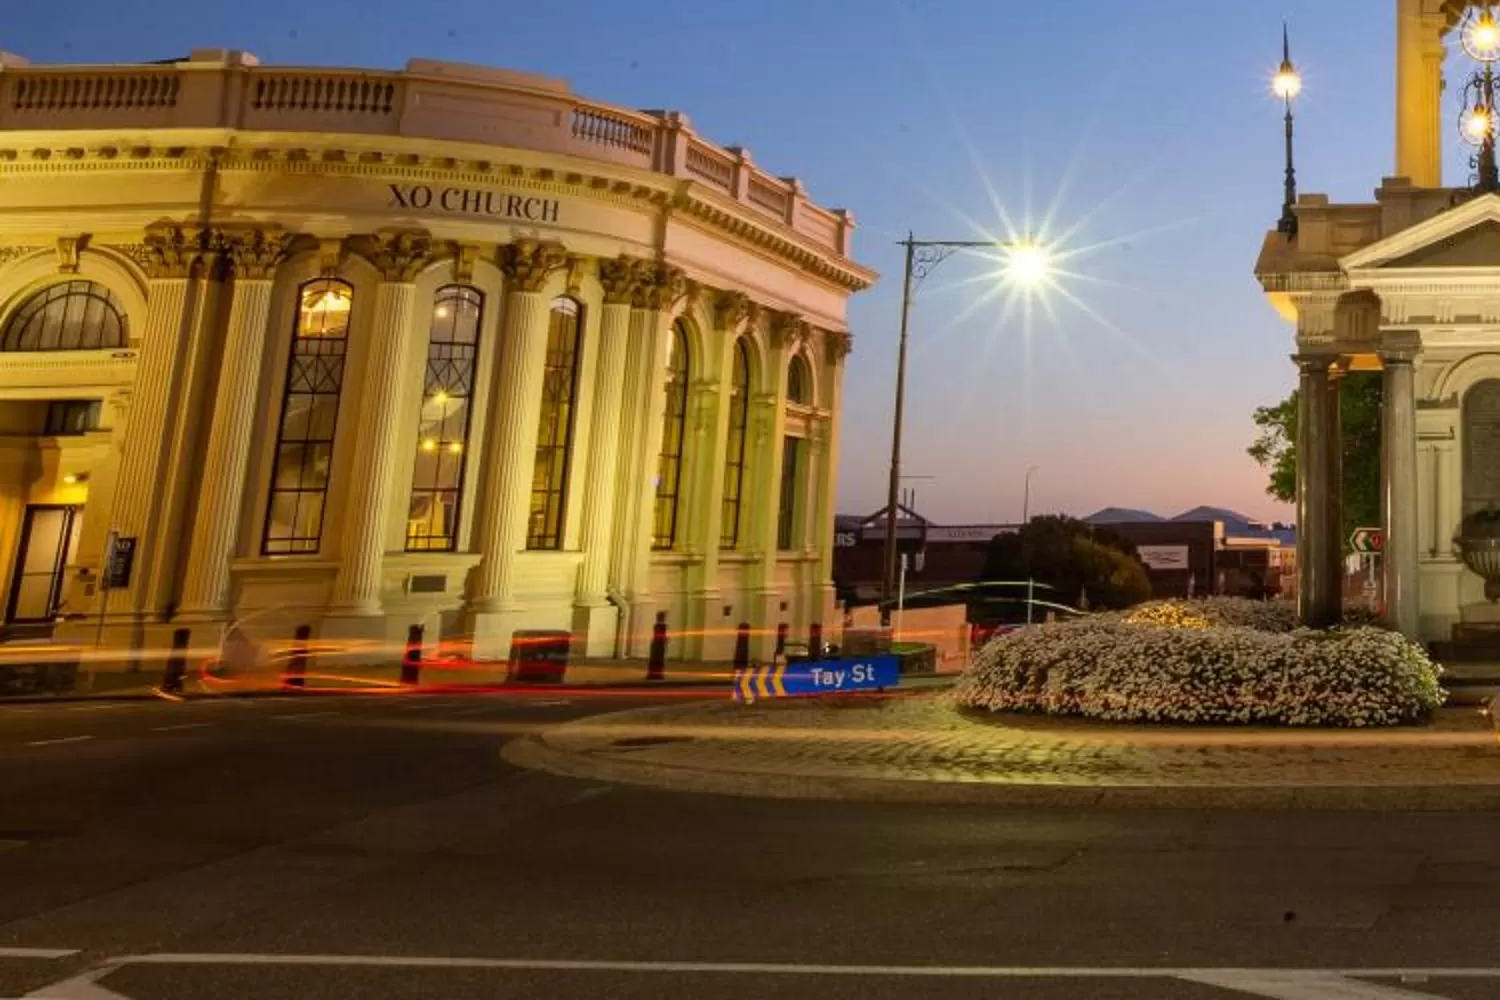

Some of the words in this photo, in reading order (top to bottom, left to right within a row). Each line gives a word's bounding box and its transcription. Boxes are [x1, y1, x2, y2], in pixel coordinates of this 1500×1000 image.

[388, 184, 433, 209] XO
[441, 186, 561, 222] CHURCH
[811, 667, 845, 688] Tay
[852, 663, 876, 683] St
